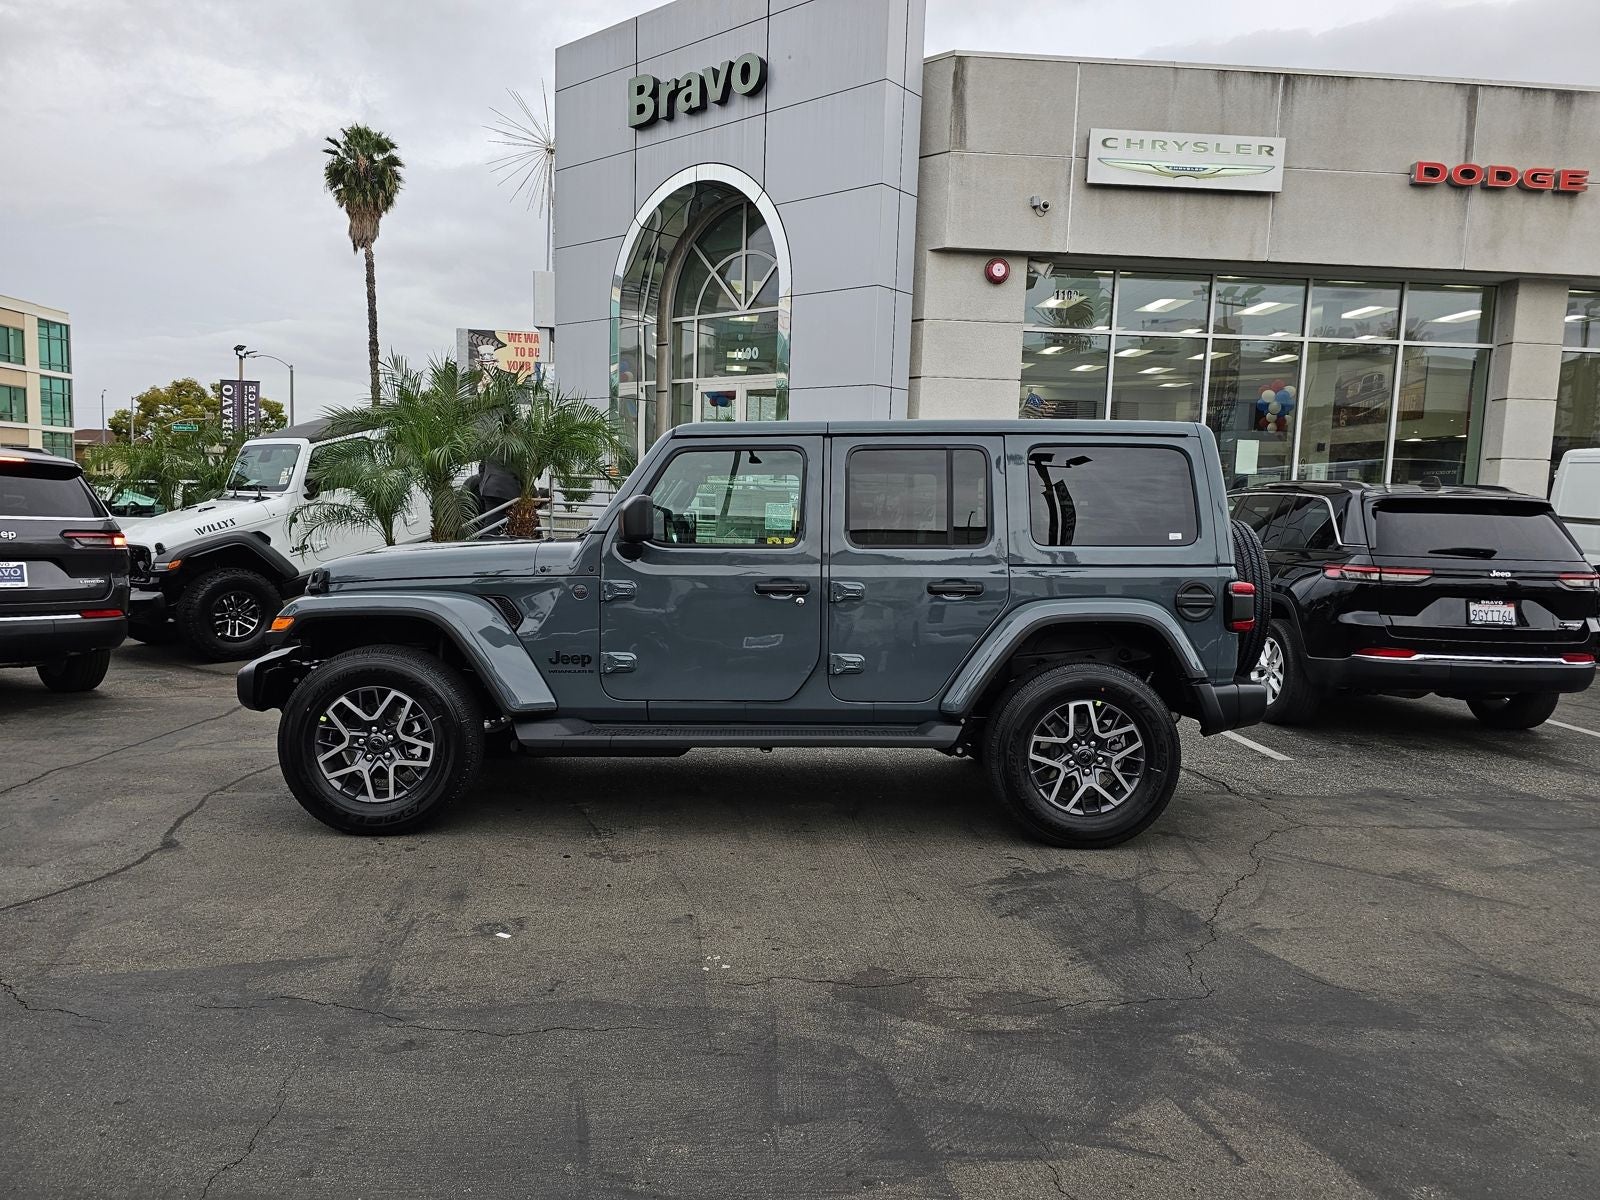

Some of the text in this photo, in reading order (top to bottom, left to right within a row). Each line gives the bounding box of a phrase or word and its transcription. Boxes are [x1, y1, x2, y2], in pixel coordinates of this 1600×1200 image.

[628, 52, 766, 129] Bravo
[1101, 137, 1275, 156] CHRYSLER
[1410, 161, 1589, 193] DODGE
[507, 333, 522, 343] WE
[514, 347, 525, 357] TO
[507, 360, 531, 371] YOUR
[194, 518, 236, 536] WILLYS
[1471, 609, 1515, 622] 9GYT764
[548, 650, 592, 668] Jeep
